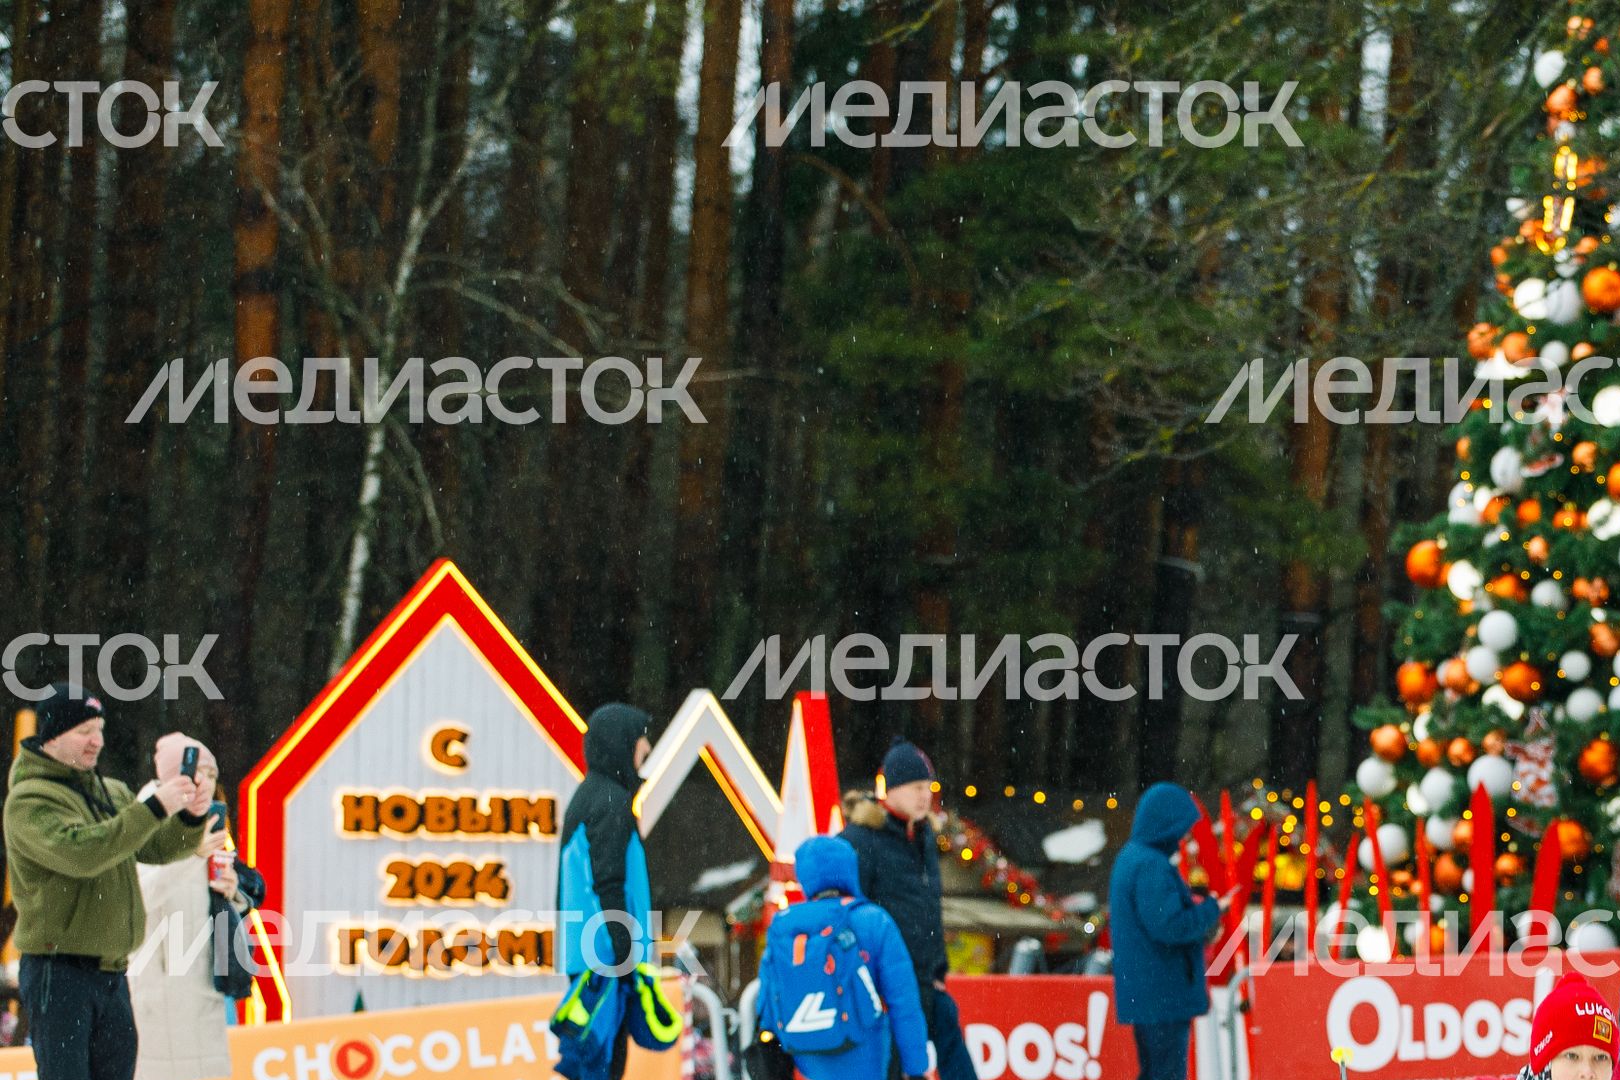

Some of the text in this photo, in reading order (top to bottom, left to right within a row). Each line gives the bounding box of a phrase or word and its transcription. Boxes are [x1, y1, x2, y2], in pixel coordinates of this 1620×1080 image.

[430, 727, 469, 769] С
[342, 793, 558, 836] НОВЫМ
[385, 861, 510, 901] 2024
